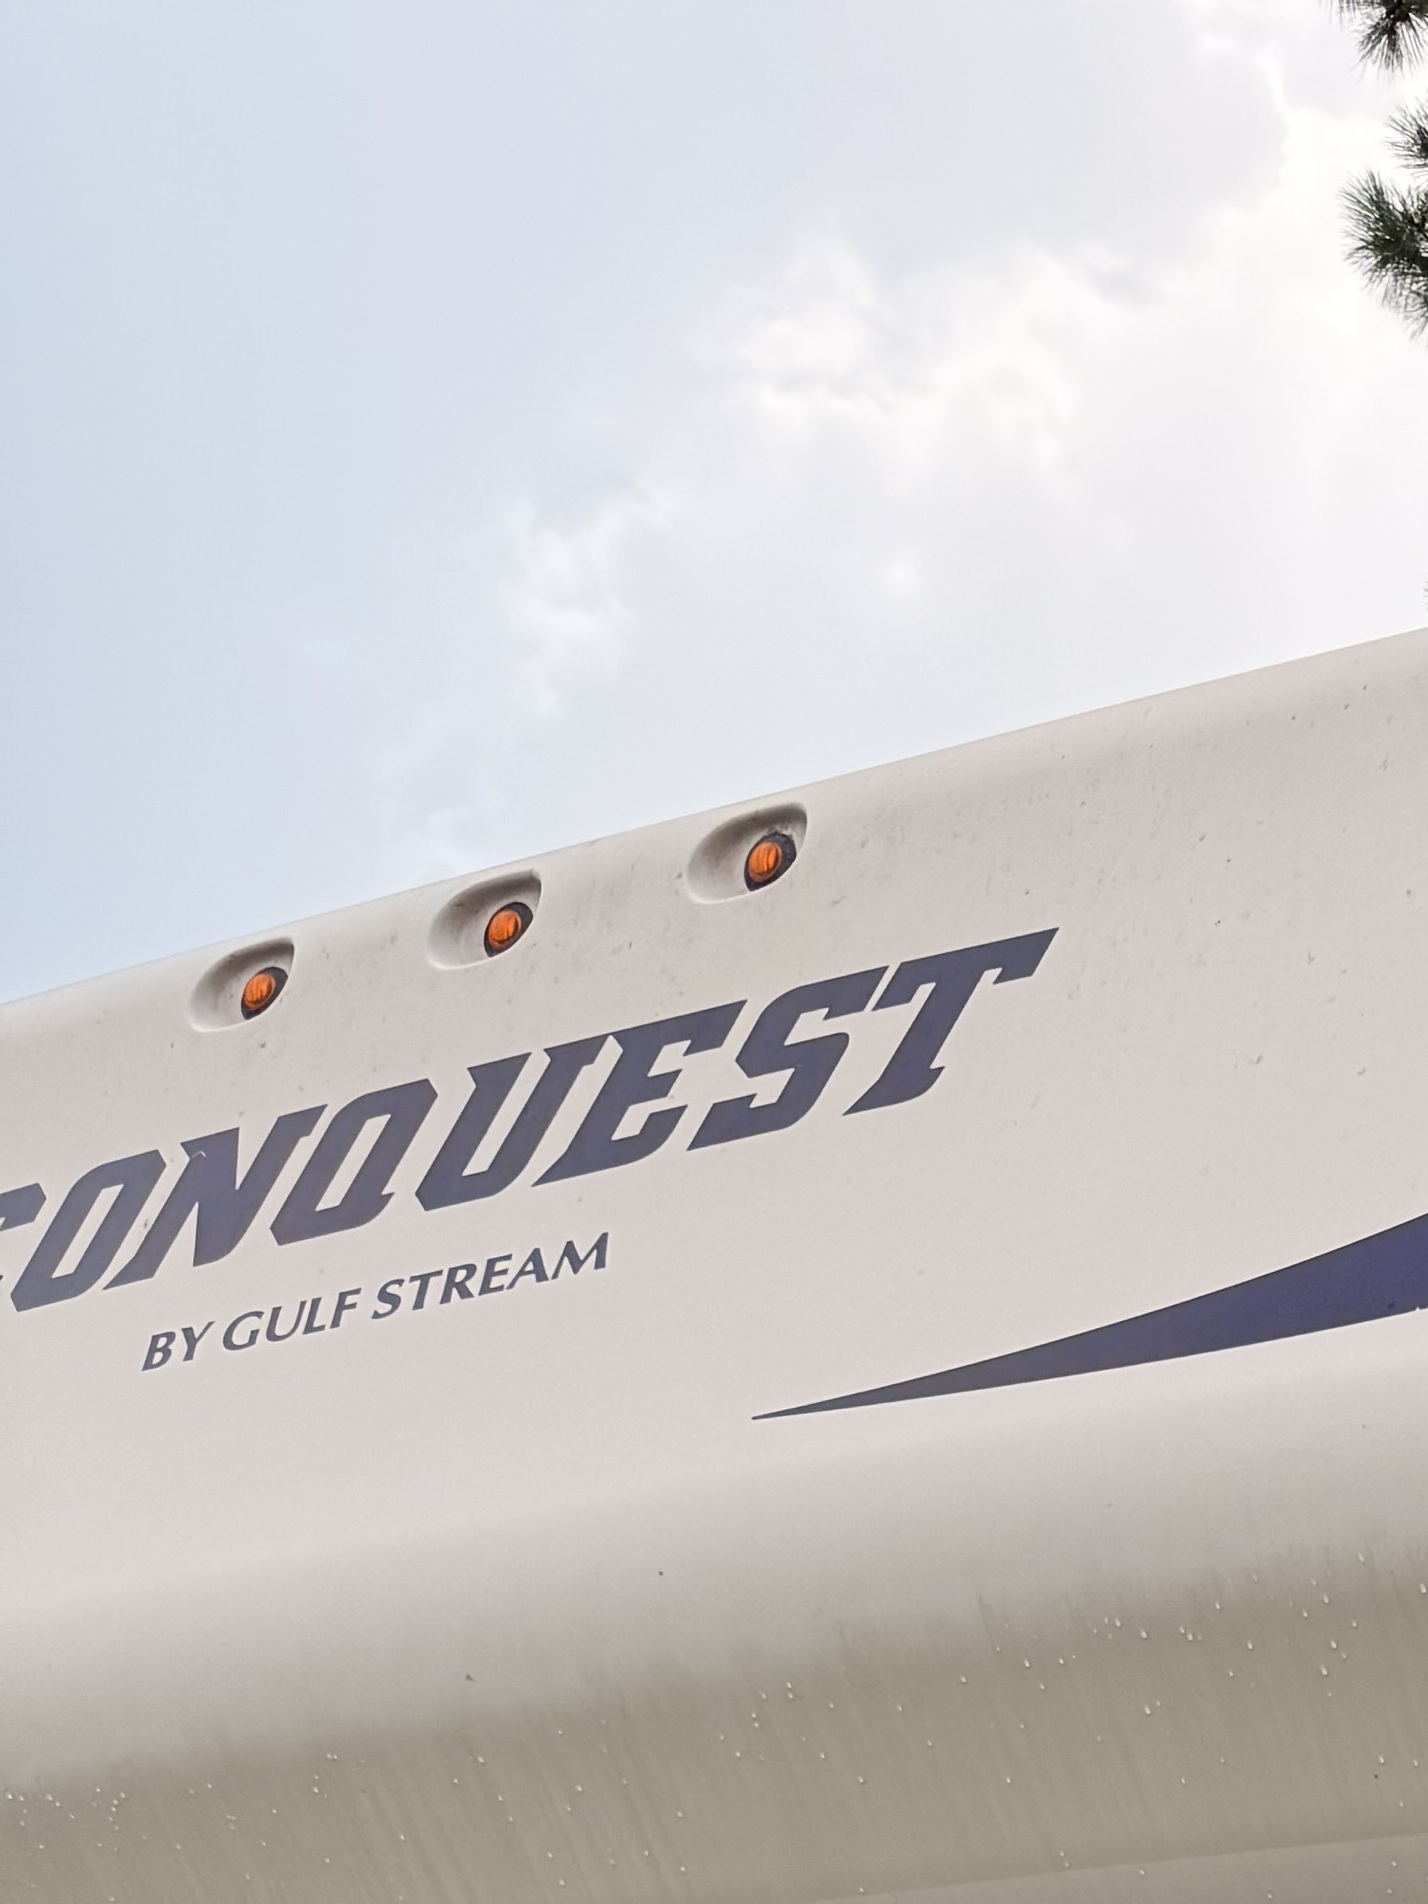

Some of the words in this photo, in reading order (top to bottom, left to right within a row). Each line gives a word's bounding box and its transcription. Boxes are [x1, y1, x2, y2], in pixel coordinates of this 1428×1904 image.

[0, 928, 1059, 1312] ONQUEST
[141, 1321, 216, 1372] BY
[222, 1287, 362, 1351] GULF
[370, 1232, 610, 1320] STREAM
